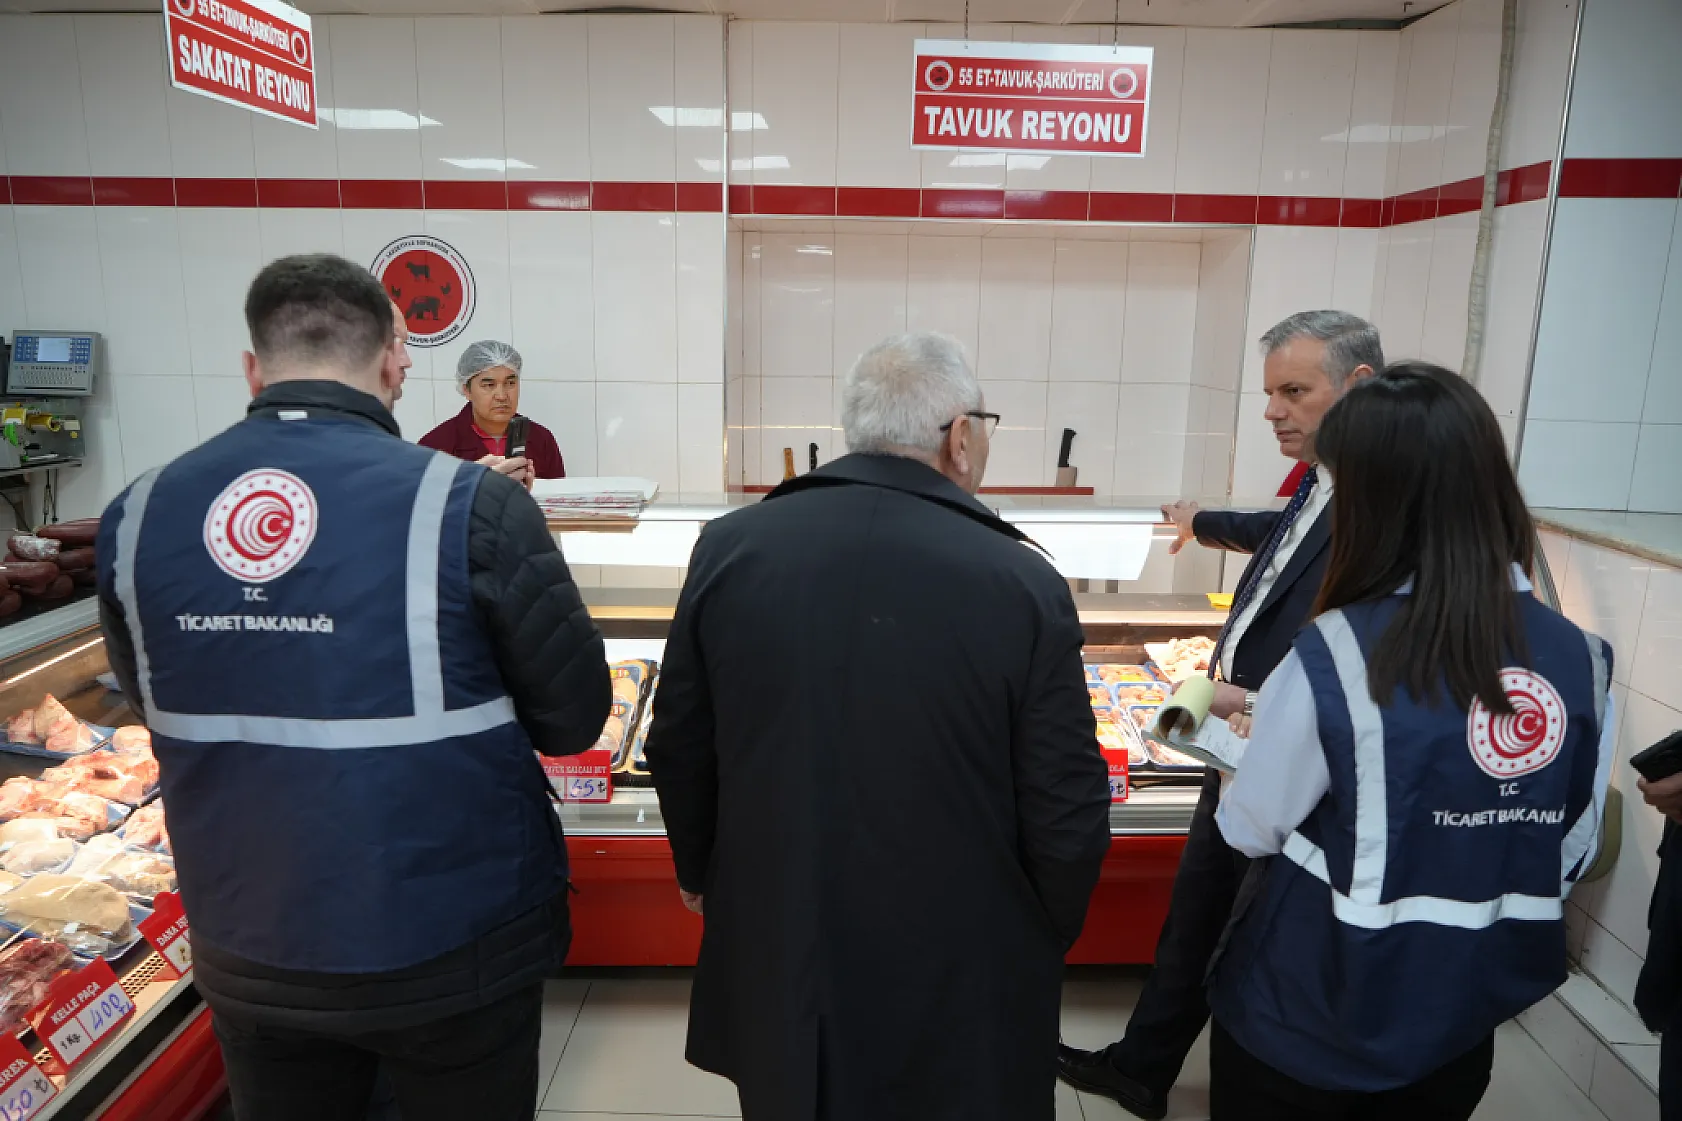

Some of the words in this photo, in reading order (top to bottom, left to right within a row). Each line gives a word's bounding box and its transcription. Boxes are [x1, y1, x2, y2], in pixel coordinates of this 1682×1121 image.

[178, 34, 252, 93] SAKATAT
[255, 63, 310, 112] REYONU
[958, 67, 973, 86] 55
[975, 68, 1104, 93] ET-TAVUK-ŞARKÜTERİ
[924, 105, 1014, 139] TAVUK
[1021, 110, 1132, 143] REYONU
[242, 586, 268, 602] T.C.
[175, 613, 242, 632] TİCARET
[243, 612, 334, 633] BAKANLIĞI
[1432, 810, 1497, 828] TİCARET
[50, 998, 81, 1025] KELLE
[77, 981, 102, 1002] PAÇA
